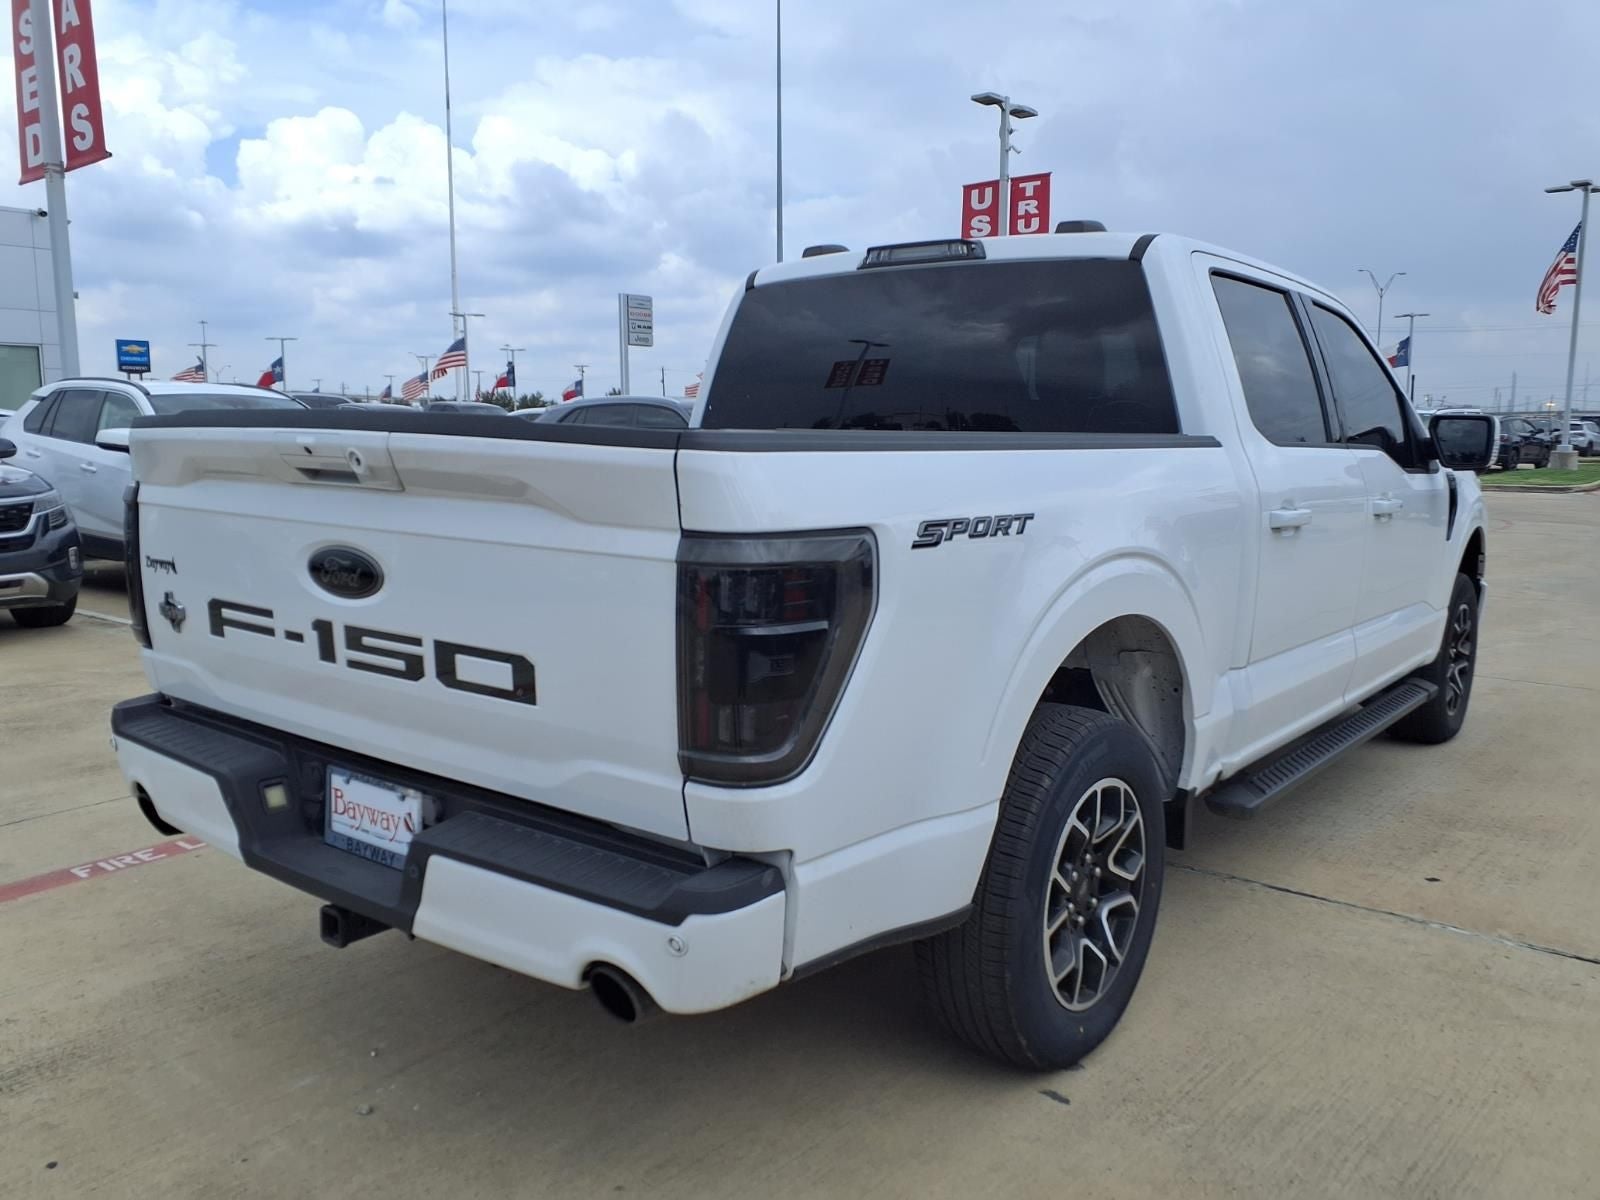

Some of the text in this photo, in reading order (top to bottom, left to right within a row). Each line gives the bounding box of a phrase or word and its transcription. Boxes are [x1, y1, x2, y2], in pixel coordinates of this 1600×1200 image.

[911, 512, 1035, 550] SPORT
[319, 555, 362, 588] Ford
[207, 597, 537, 706] F-150
[331, 786, 401, 842] Bayway
[69, 847, 167, 878] FIRE
[345, 837, 397, 866] BAYWAY
